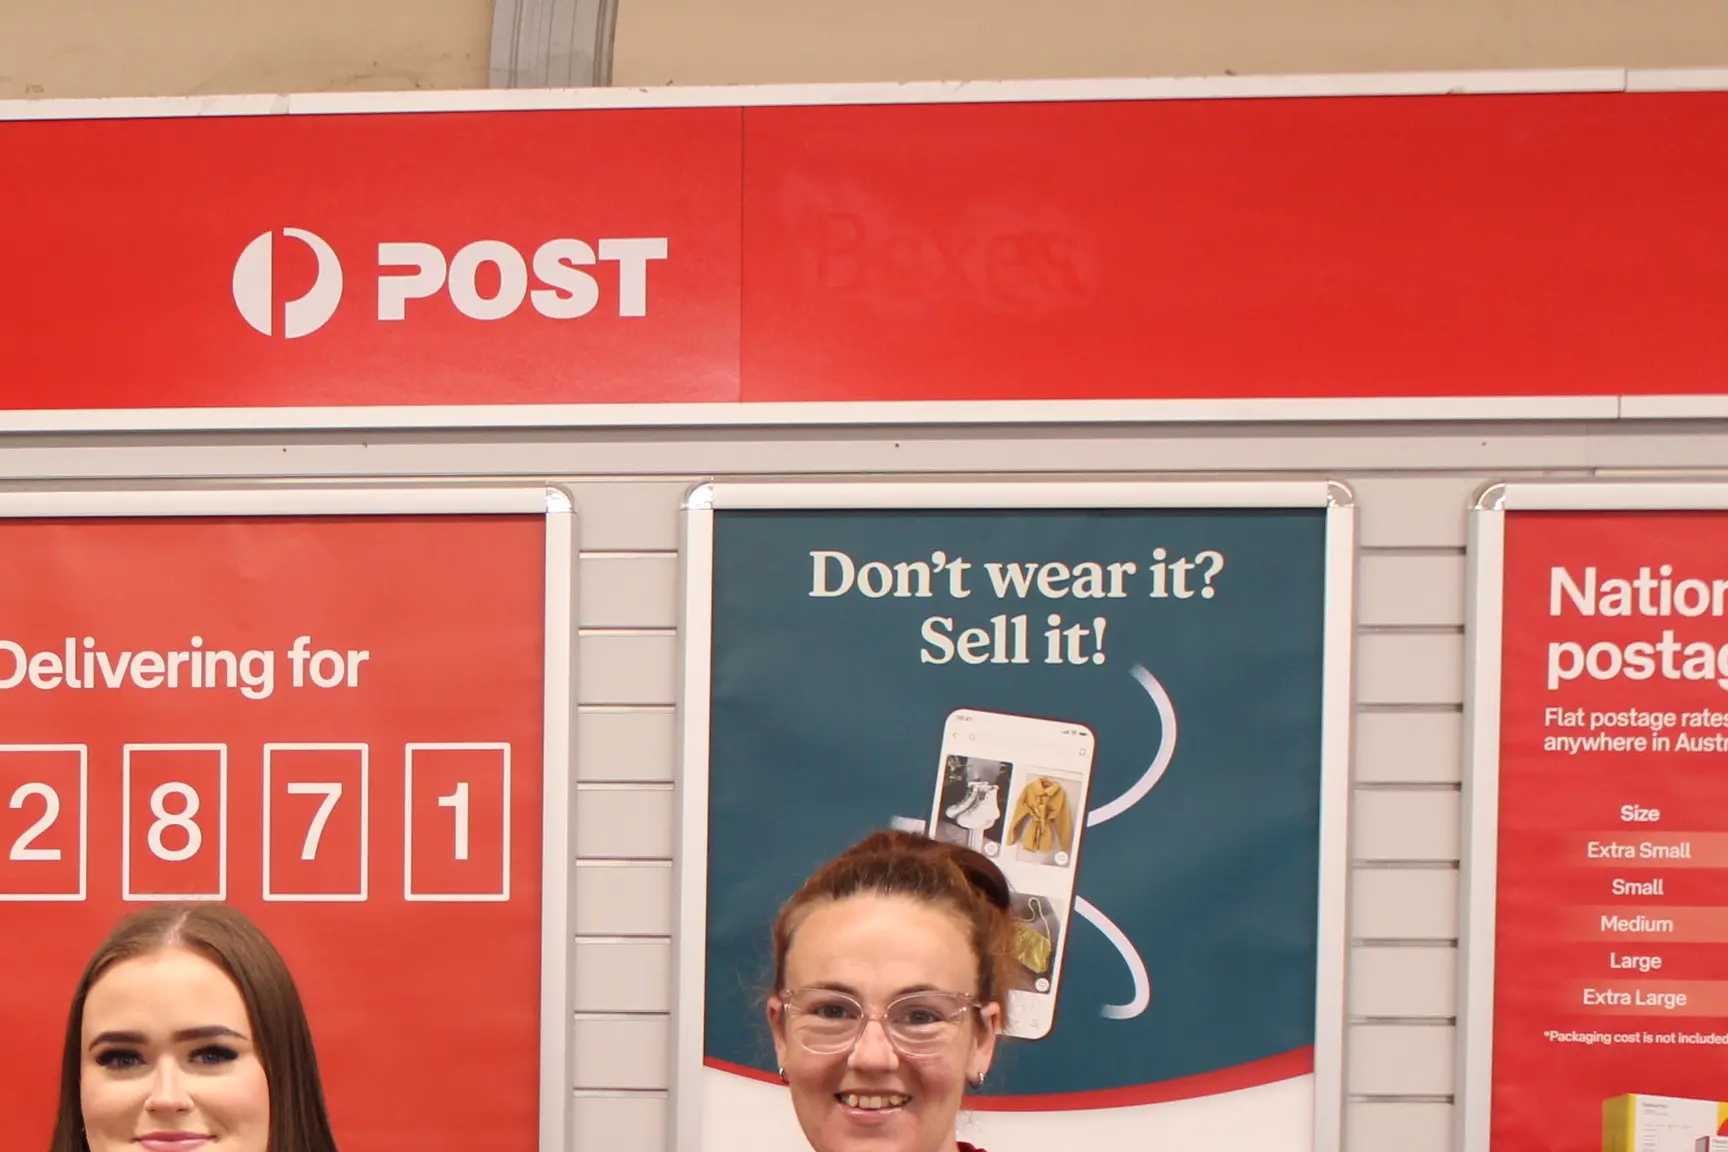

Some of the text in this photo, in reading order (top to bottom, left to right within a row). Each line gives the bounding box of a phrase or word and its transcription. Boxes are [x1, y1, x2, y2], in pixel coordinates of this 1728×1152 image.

[377, 237, 668, 320] POST
[808, 547, 1225, 600] Don't wear it?
[920, 614, 1107, 665] Sell it!
[287, 635, 370, 688] for
[1545, 707, 1585, 727] Flat
[1590, 707, 1676, 730] postage
[1544, 732, 1647, 755] anywhere
[1652, 733, 1670, 751] in
[8, 781, 469, 861] 2 8 7 1
[1620, 804, 1660, 822] Size
[1587, 841, 1691, 859] Extra Small
[1612, 878, 1664, 895] Small
[1600, 915, 1673, 932] Medium
[1610, 953, 1662, 972] Large
[1583, 988, 1687, 1010] Extra Large
[1613, 1032, 1640, 1044] cost
[1642, 1031, 1653, 1044] is
[1655, 1032, 1676, 1044] not
[1678, 1031, 1728, 1045] included
